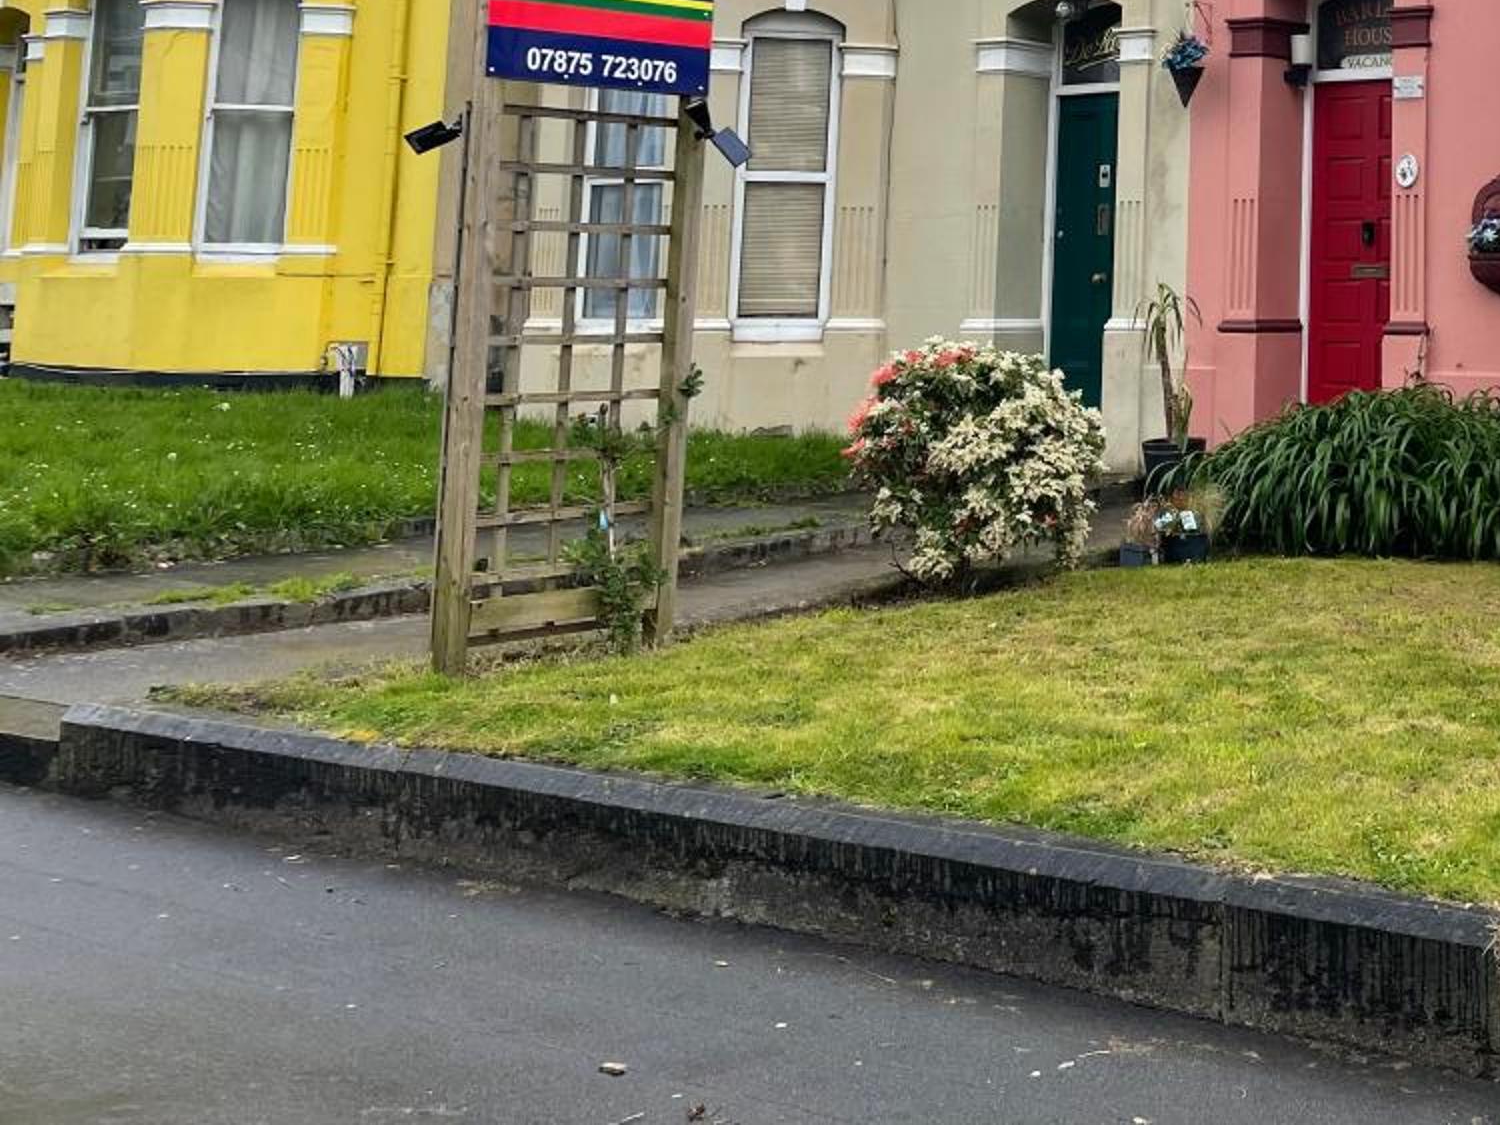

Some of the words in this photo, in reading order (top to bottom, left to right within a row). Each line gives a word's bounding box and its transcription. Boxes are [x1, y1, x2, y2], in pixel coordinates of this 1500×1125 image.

[1336, 0, 1392, 25] BARL
[1345, 26, 1392, 45] HOUS
[527, 47, 593, 75] 07875
[601, 54, 677, 83] 723076
